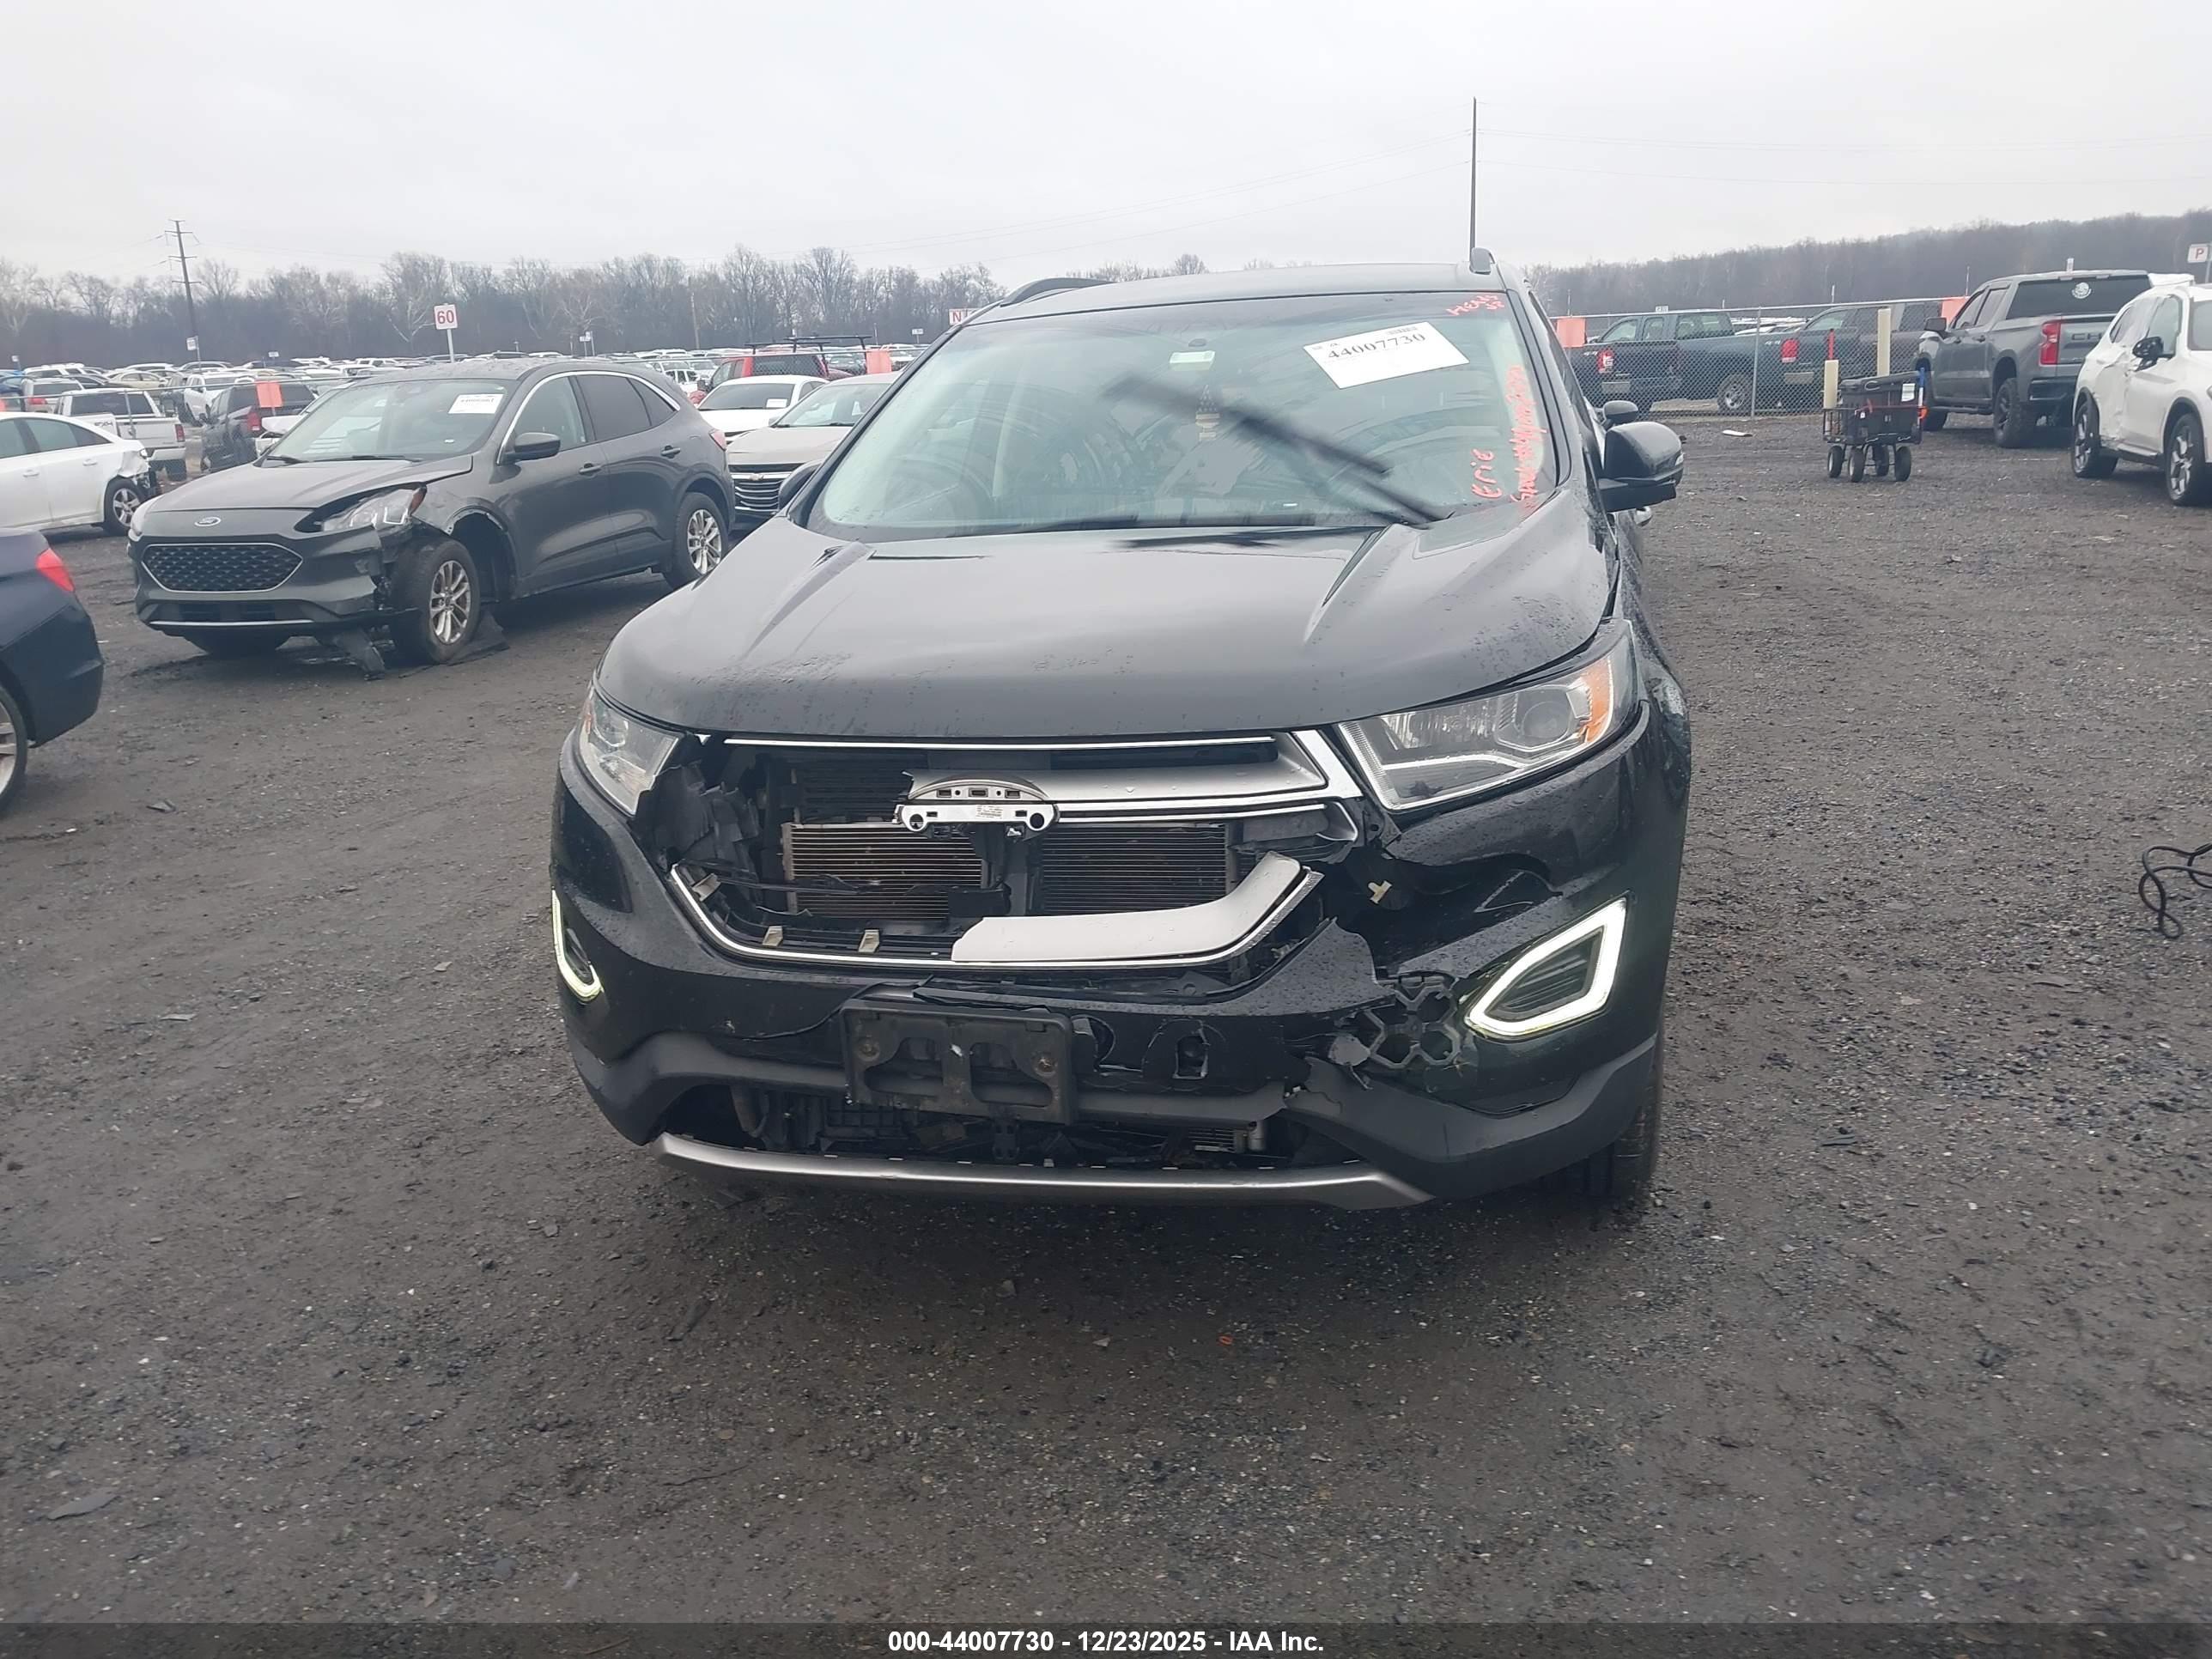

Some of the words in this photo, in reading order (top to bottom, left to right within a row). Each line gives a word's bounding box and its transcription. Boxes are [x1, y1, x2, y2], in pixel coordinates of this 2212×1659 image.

[2196, 248, 2204, 259] P
[437, 310, 454, 325] 60
[1328, 333, 1426, 359] 44007730
